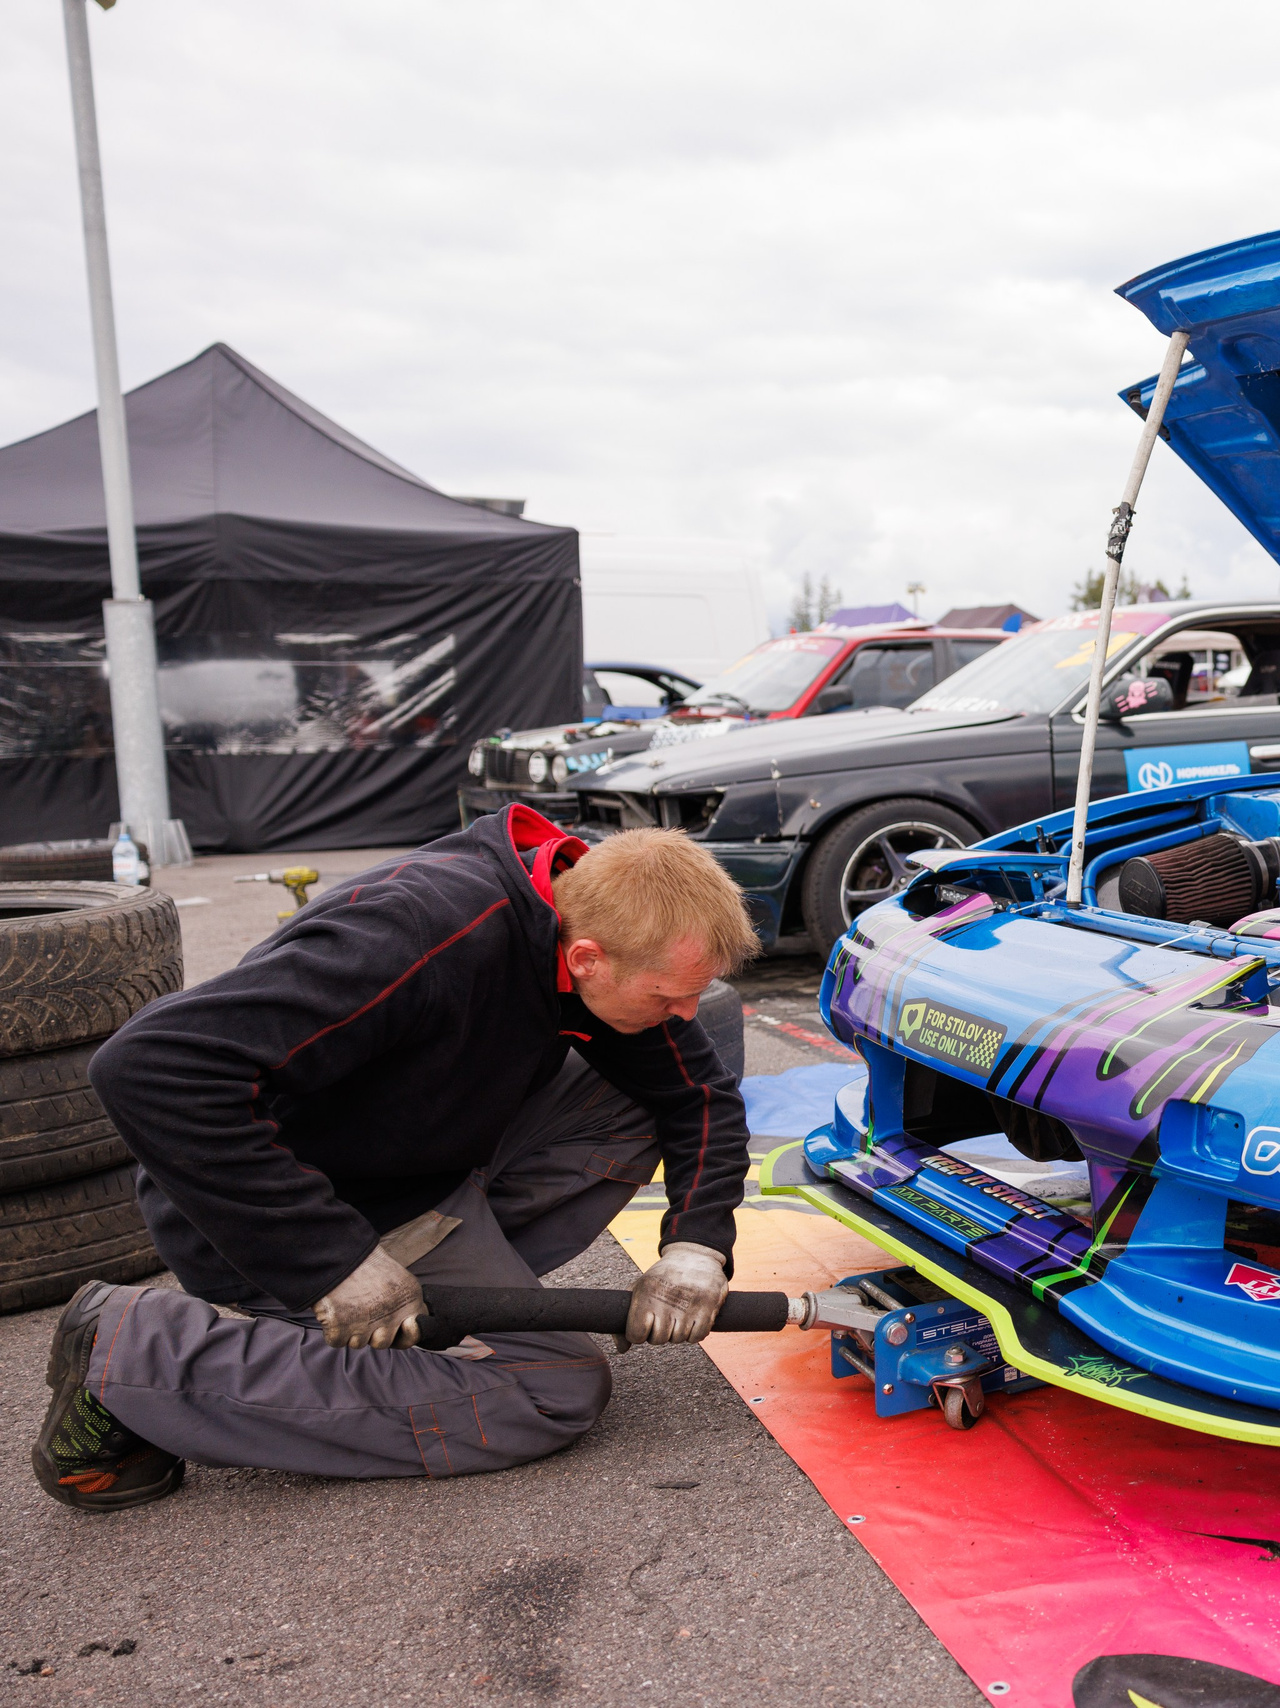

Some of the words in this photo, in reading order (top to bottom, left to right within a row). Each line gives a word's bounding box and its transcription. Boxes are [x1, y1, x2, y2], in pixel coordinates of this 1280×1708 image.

[918, 1027, 940, 1050] USE
[937, 1034, 968, 1059] ONLY
[925, 1008, 947, 1030] FOR
[944, 1015, 985, 1043] STILOV
[919, 1153, 975, 1177] KEEP
[961, 1174, 997, 1188] IT
[982, 1183, 1064, 1220] STREET
[921, 1201, 984, 1239] PARTS
[922, 1316, 991, 1340] STELS
